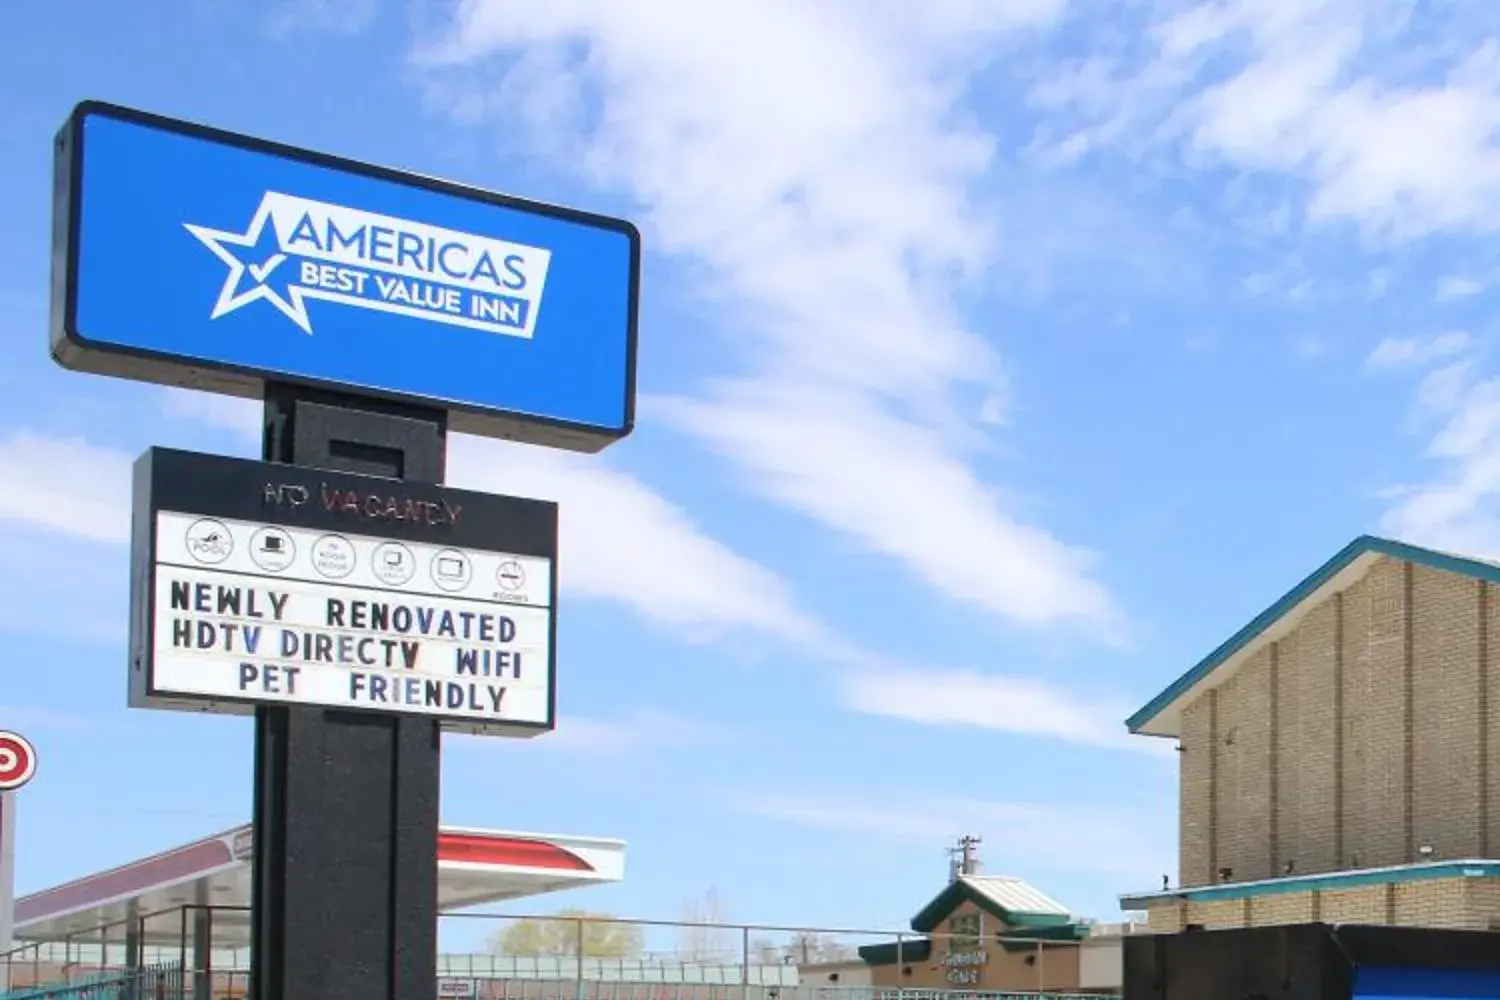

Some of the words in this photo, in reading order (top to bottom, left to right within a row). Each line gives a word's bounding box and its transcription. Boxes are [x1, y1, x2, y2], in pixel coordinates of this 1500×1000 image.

[288, 210, 527, 290] AMERICAS
[300, 261, 368, 294] BEST
[374, 275, 461, 314] VALUE
[471, 295, 520, 324] INN
[264, 481, 309, 505] NO
[321, 481, 462, 526] VACANCY
[171, 580, 289, 621] NEWLY
[326, 598, 517, 643] RENOVATED
[173, 618, 262, 654] HDTV
[280, 629, 420, 669] DIRECTV
[456, 647, 522, 679] WIFI
[239, 661, 300, 694] PET
[350, 672, 507, 713] FRIENDLY
